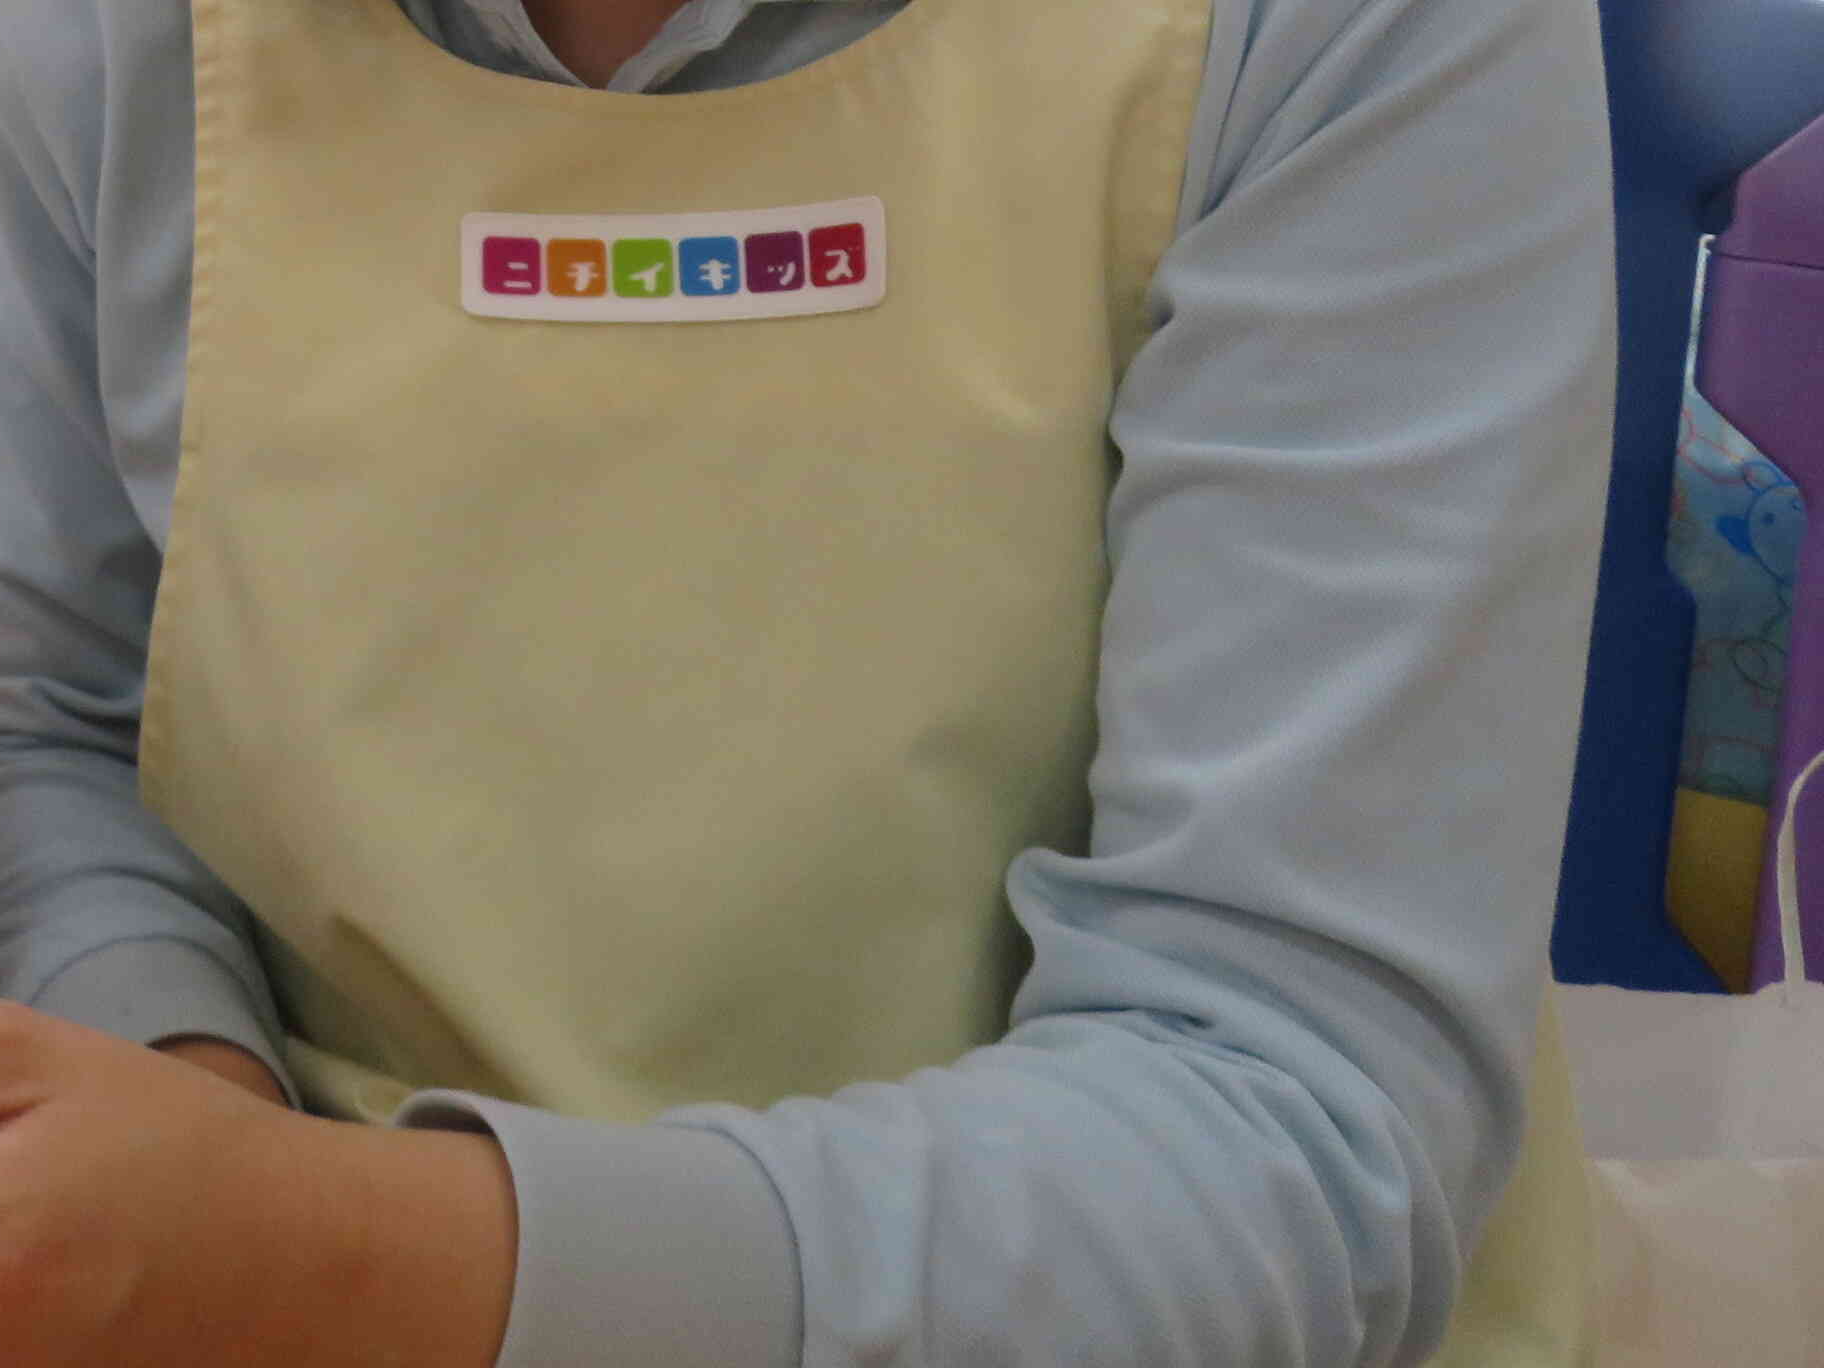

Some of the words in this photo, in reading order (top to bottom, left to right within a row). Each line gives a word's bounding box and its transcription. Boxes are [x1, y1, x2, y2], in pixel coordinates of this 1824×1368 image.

[500, 242, 862, 294] ニチイキッズ
